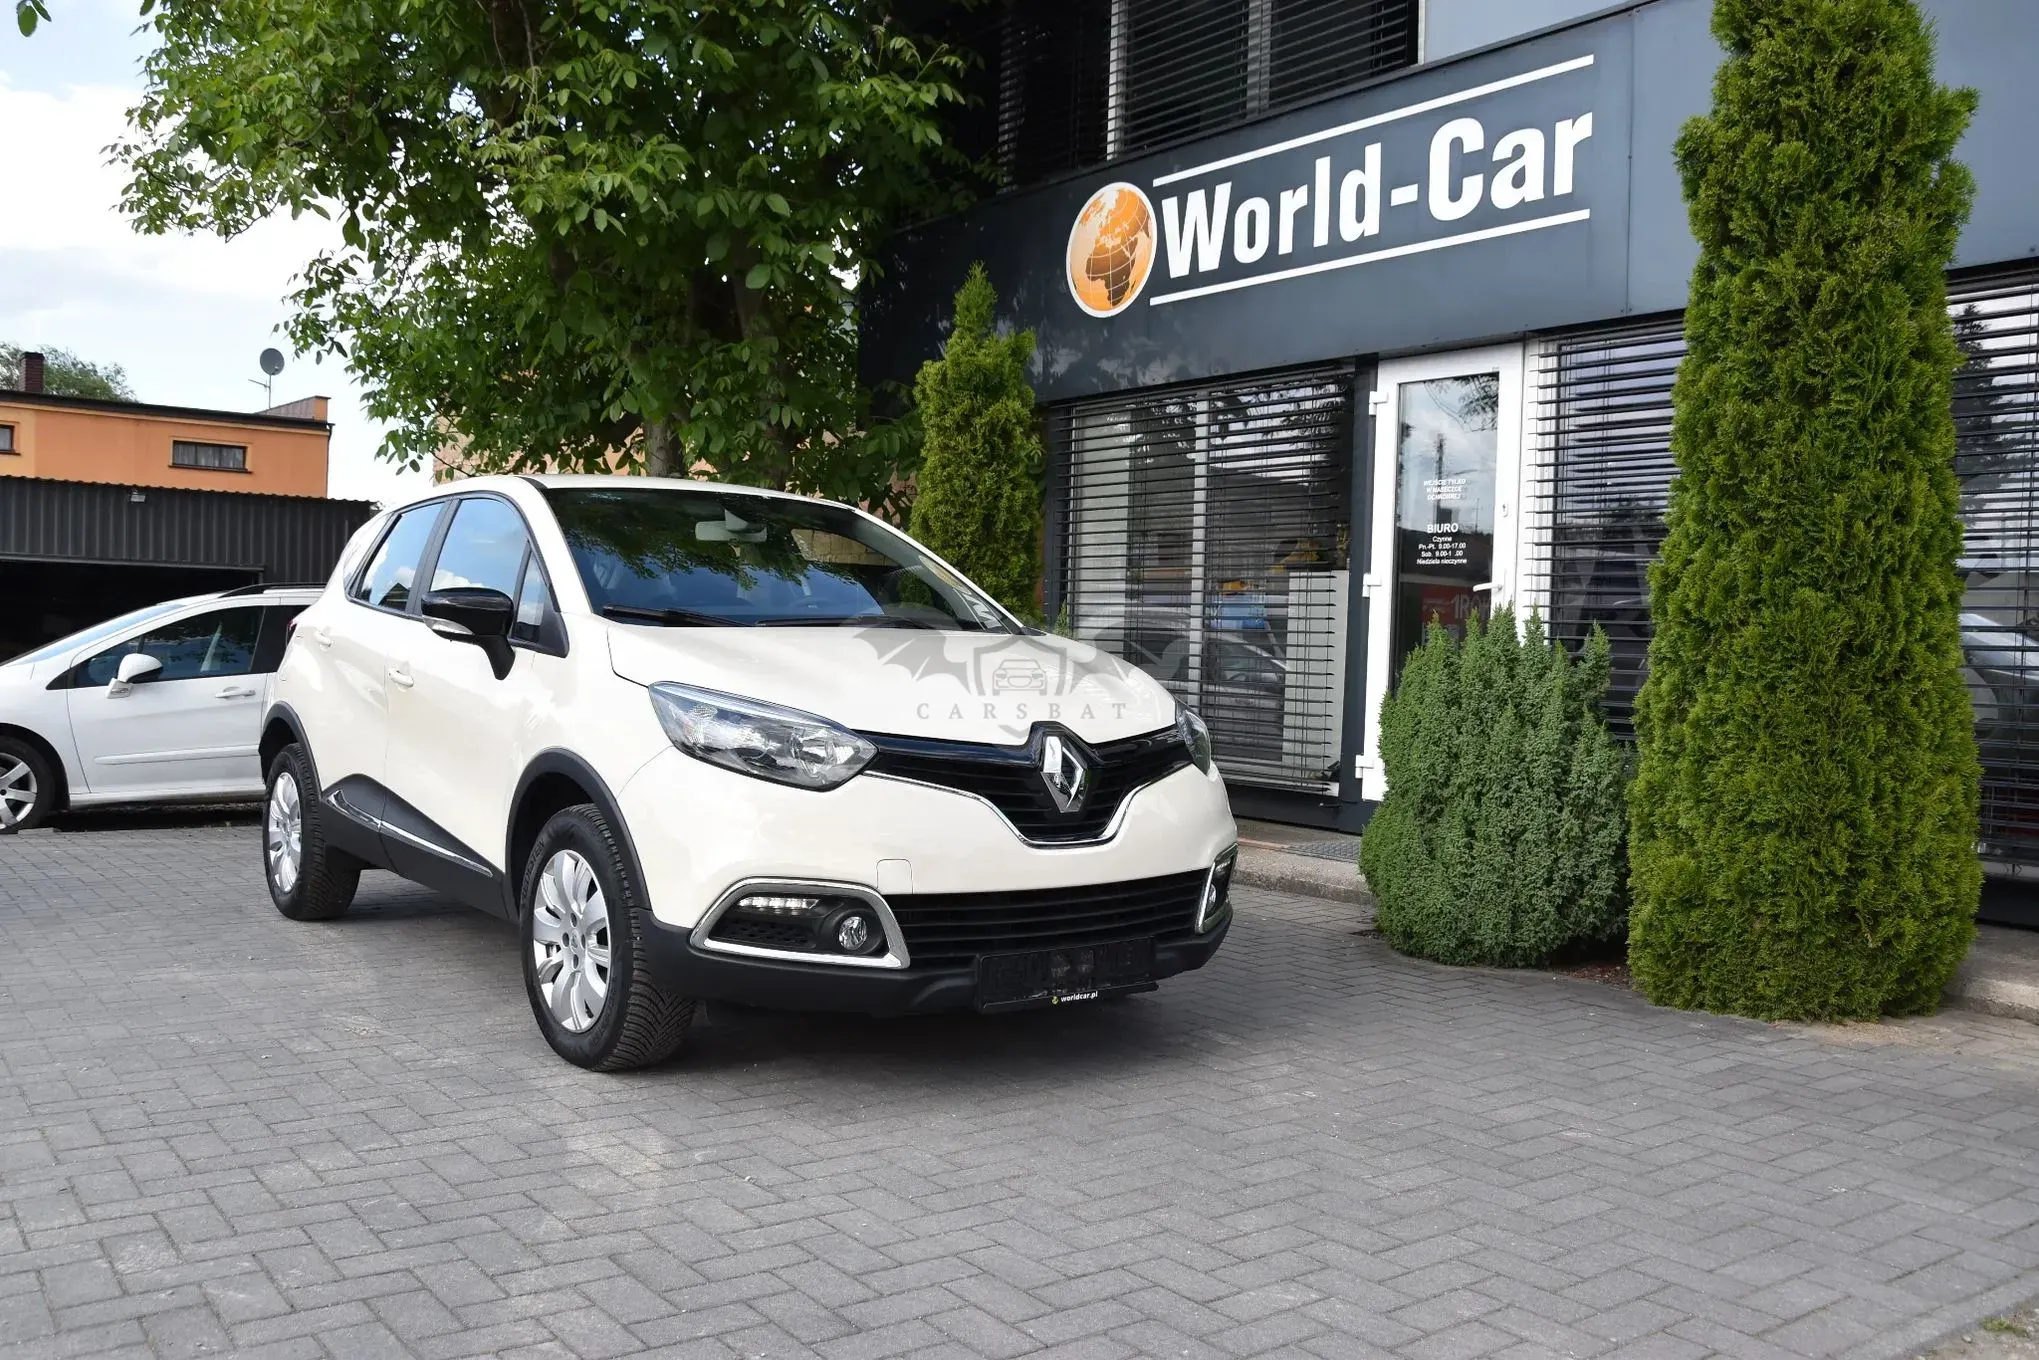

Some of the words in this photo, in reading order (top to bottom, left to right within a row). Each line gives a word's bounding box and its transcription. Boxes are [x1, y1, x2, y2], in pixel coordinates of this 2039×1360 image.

[1162, 113, 1593, 279] World-Car
[1427, 523, 1459, 533] BIURO
[1061, 990, 1098, 1002] worldcar.pl
